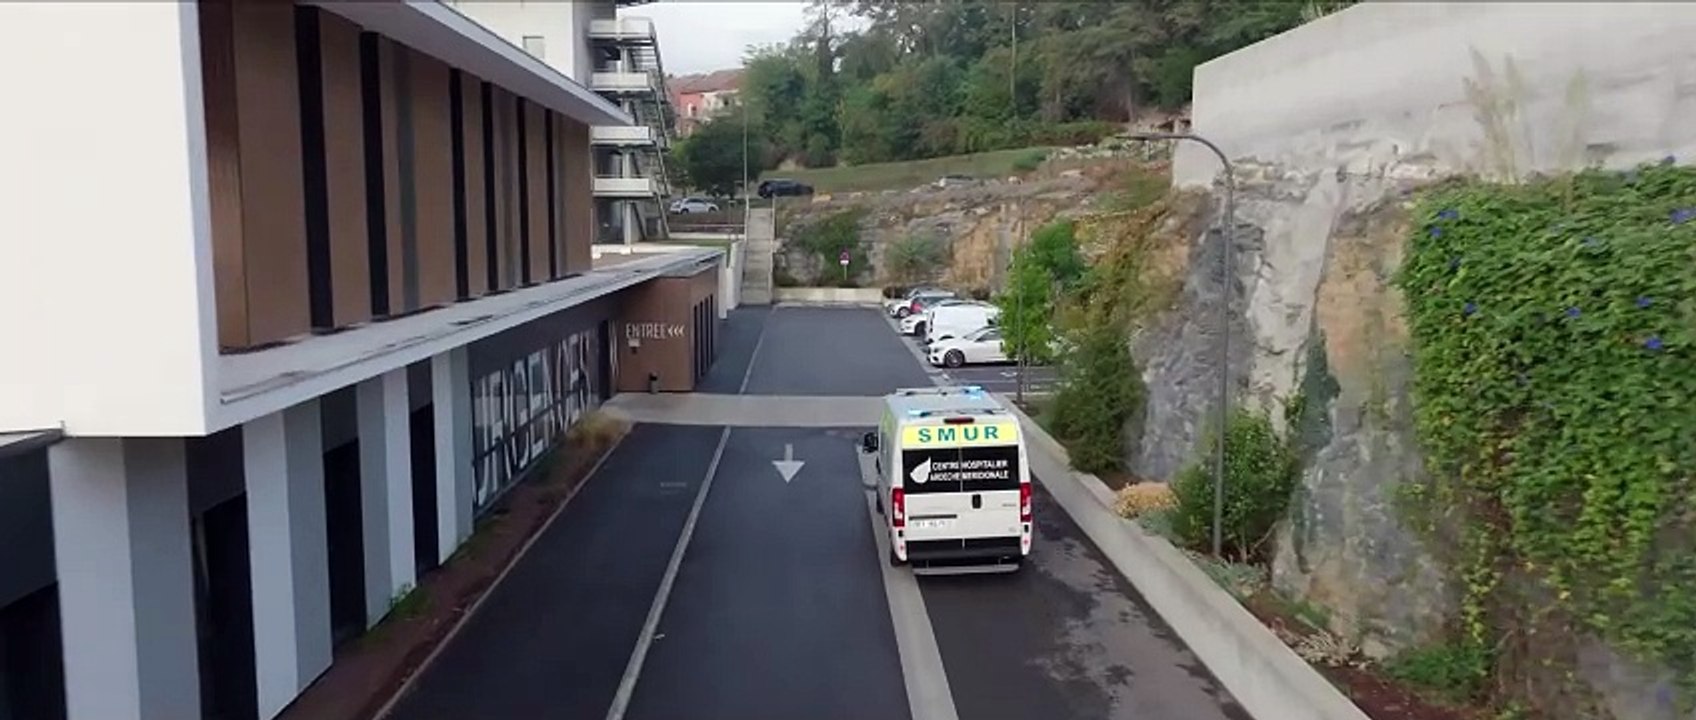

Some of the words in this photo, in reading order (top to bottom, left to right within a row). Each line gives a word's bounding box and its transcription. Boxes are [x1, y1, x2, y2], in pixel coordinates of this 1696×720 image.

[918, 426, 999, 443] SMUR
[932, 461, 959, 471] CENTRE
[961, 460, 1008, 470] HOSPITALIER
